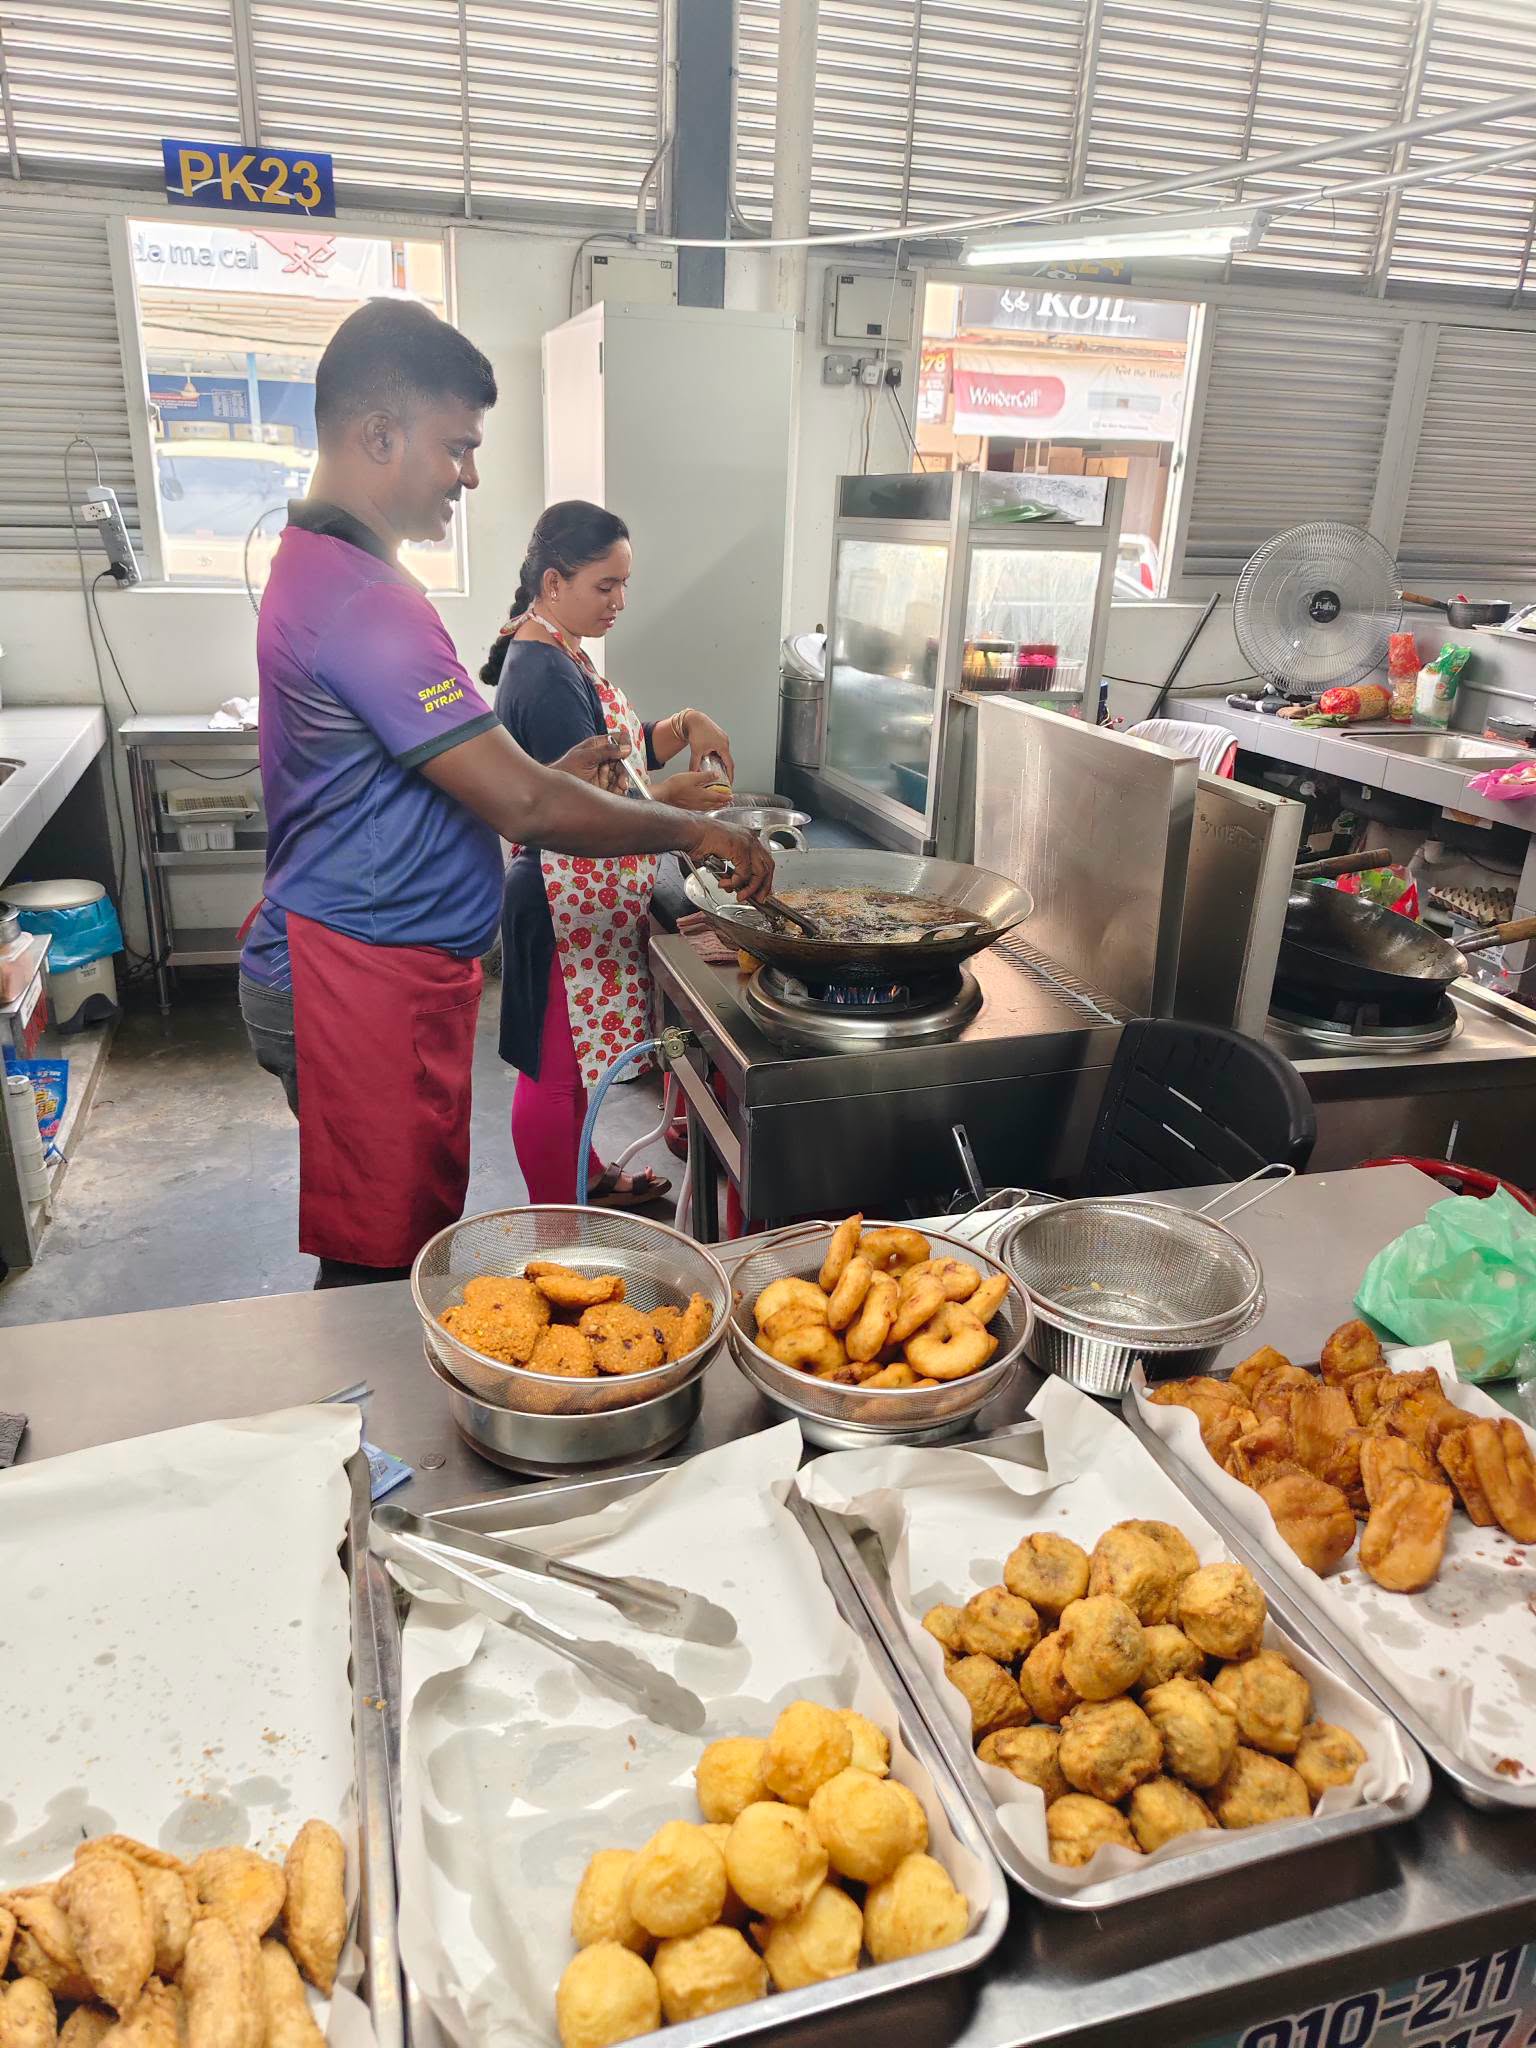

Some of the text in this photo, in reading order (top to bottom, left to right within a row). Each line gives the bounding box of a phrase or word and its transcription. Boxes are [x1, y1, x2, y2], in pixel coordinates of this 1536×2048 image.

[178, 149, 322, 208] PK23
[169, 243, 215, 267] ma
[219, 240, 259, 270] cai
[418, 677, 457, 701] SMART
[424, 689, 464, 713] BYRAM
